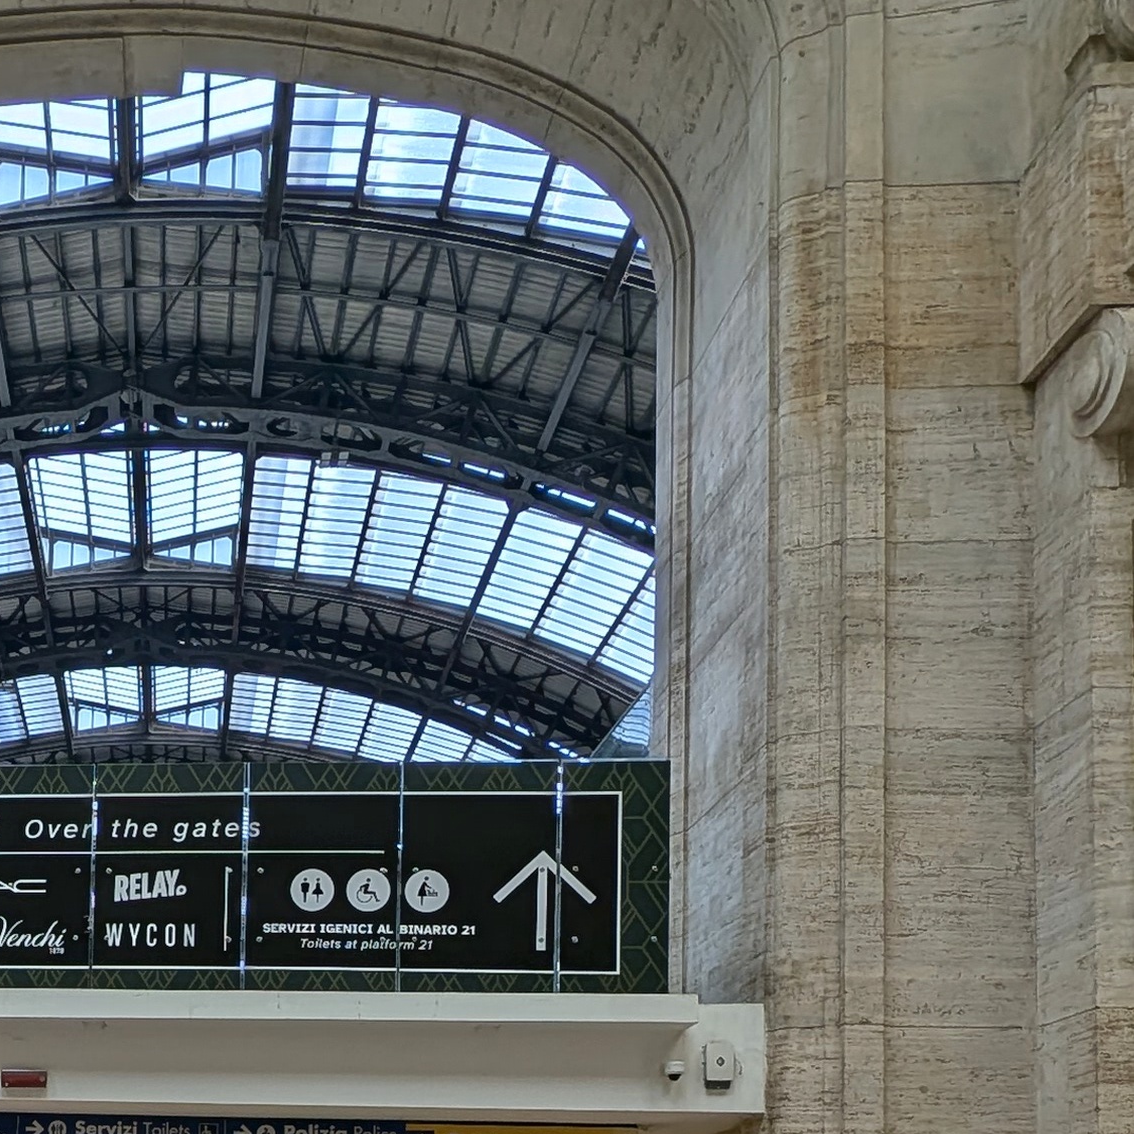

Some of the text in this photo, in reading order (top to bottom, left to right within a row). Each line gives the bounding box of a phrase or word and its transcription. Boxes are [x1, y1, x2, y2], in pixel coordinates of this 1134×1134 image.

[24, 818, 262, 843] Over the gates
[106, 922, 197, 948] WYCON
[262, 922, 476, 936] SERVIZI IGENICI AL BINARIO 21
[300, 938, 433, 951] Toilets at platform 21
